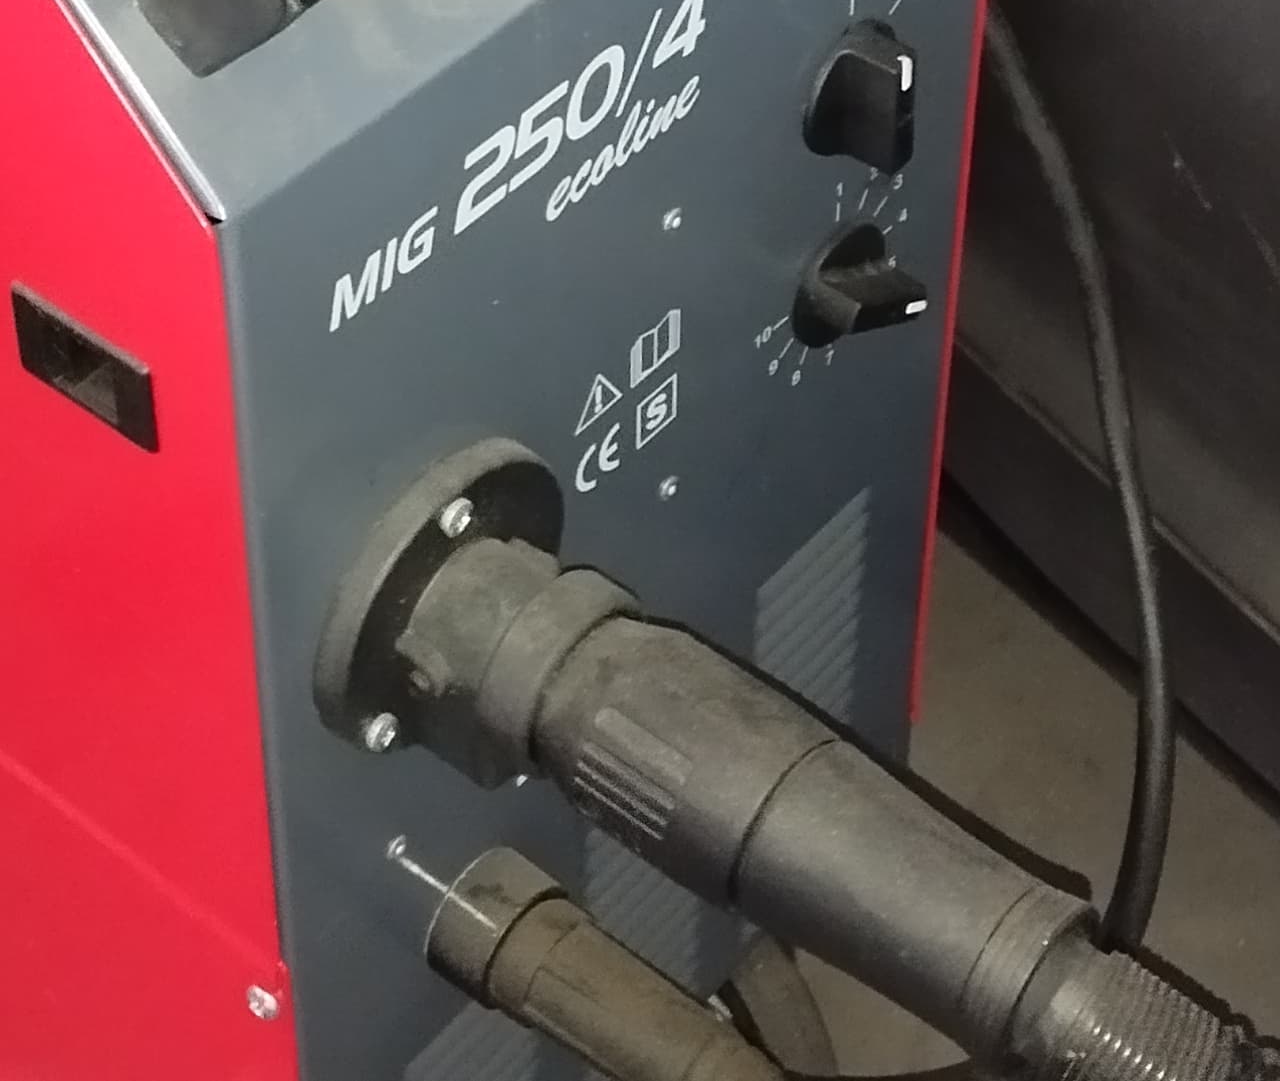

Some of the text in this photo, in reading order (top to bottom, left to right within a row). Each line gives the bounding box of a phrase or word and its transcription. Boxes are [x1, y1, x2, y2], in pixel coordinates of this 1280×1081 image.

[545, 75, 700, 221] ecoline
[836, 182, 843, 197] 1
[329, 206, 438, 332] MIG
[754, 326, 773, 348] 10
[645, 393, 667, 430] S
[575, 422, 620, 493] CE
